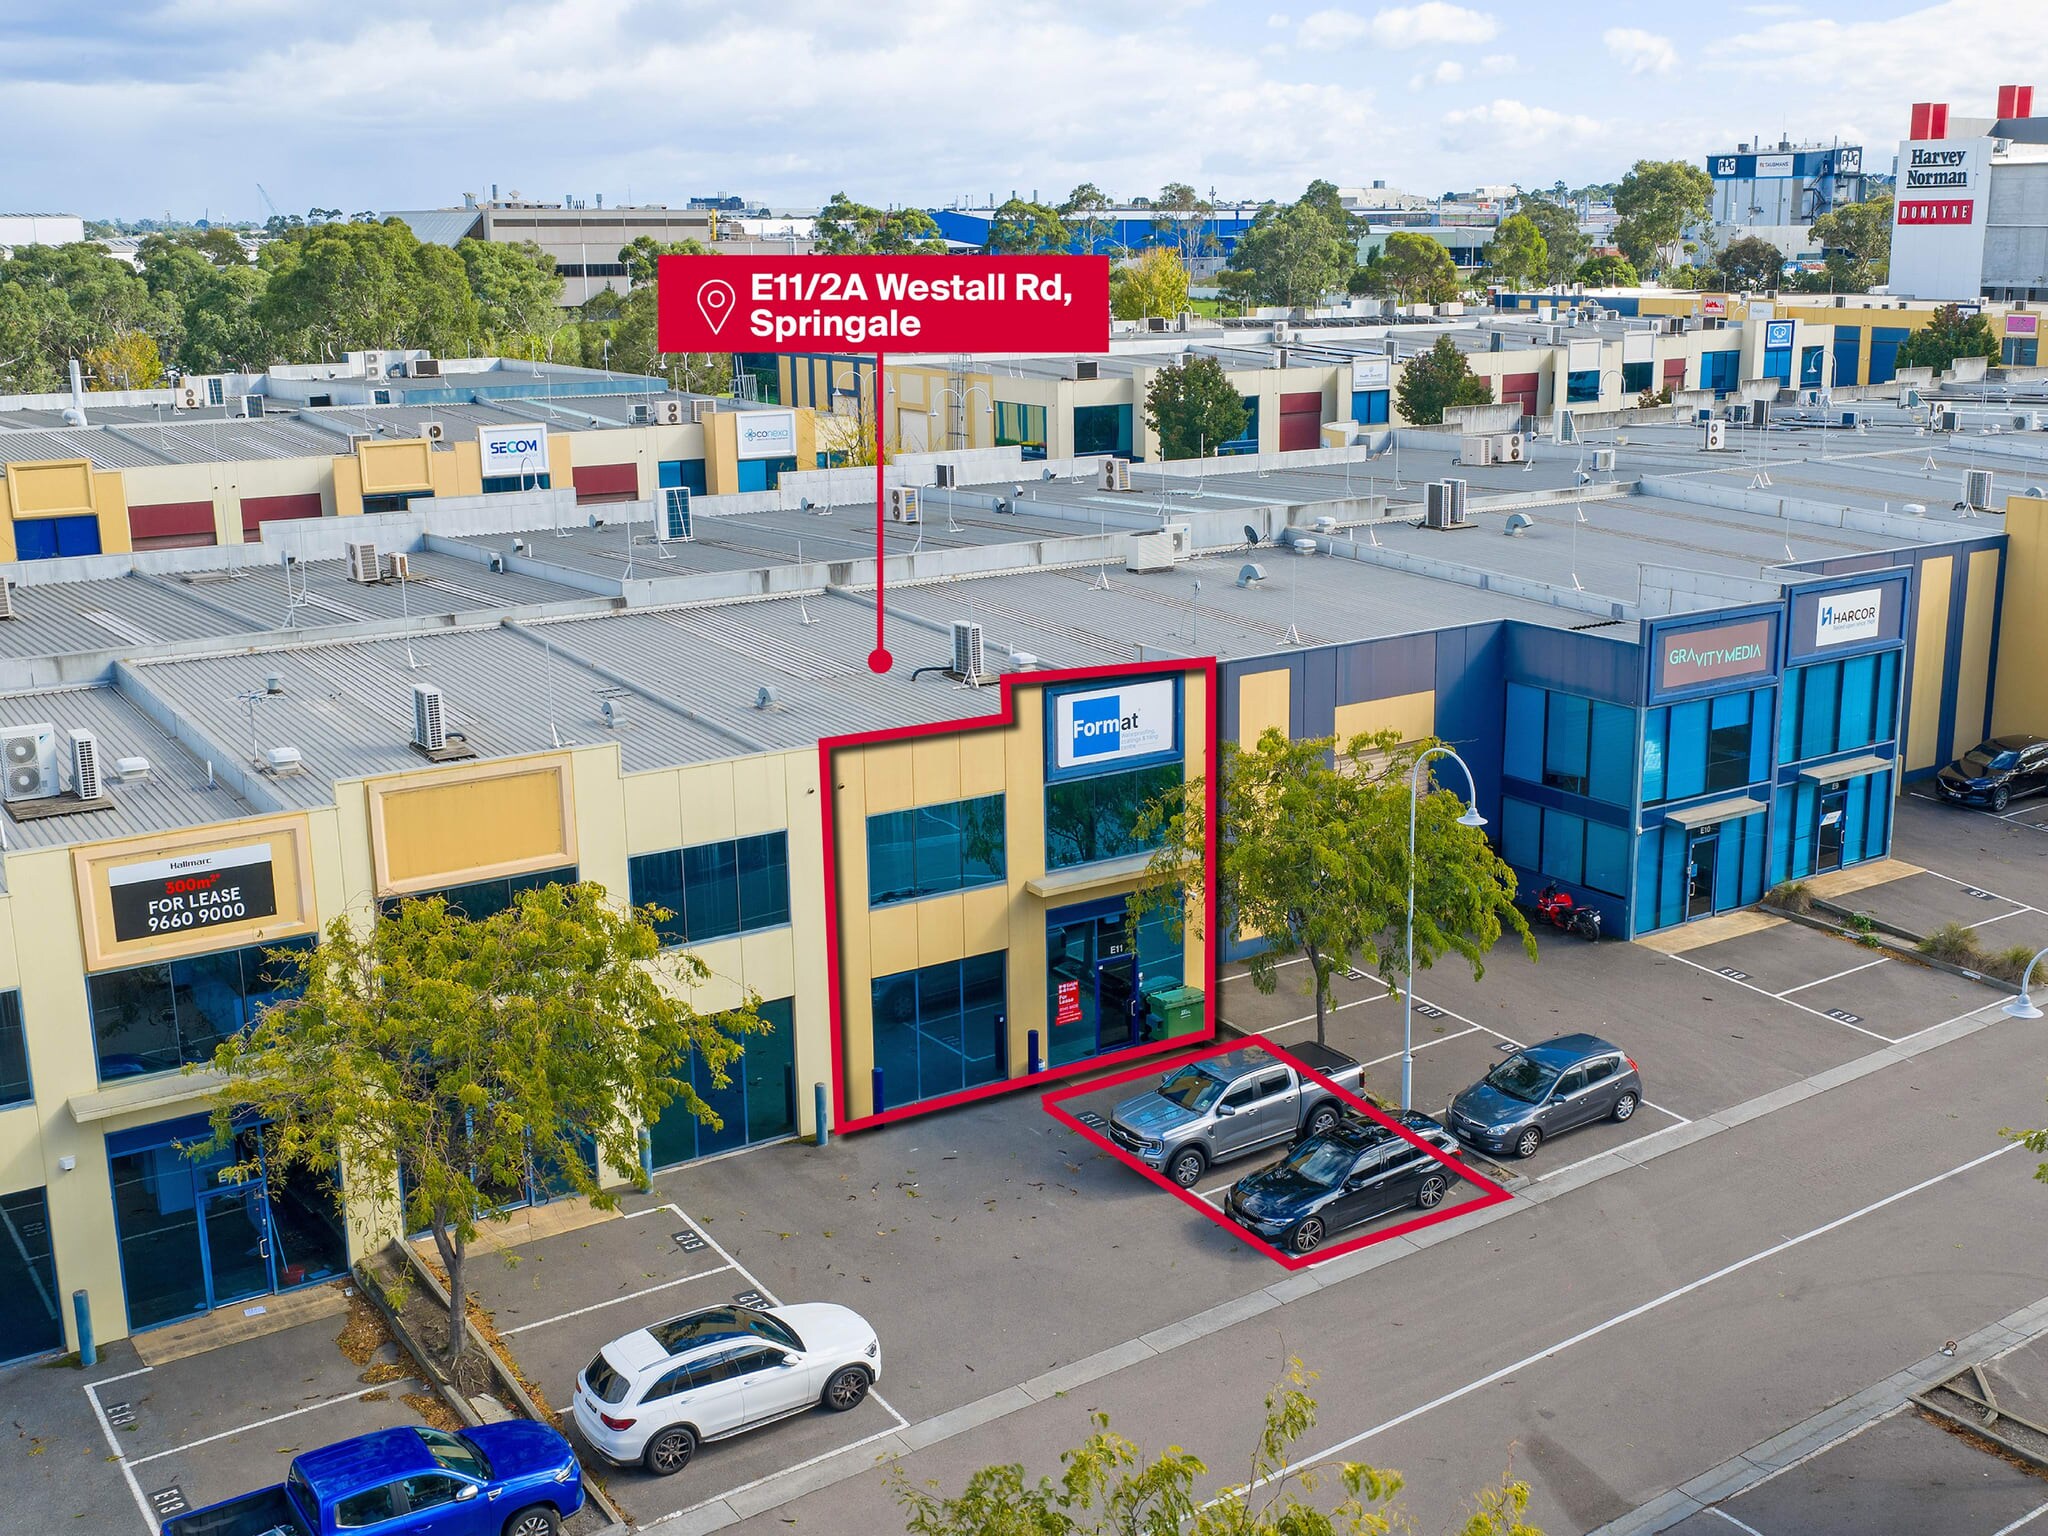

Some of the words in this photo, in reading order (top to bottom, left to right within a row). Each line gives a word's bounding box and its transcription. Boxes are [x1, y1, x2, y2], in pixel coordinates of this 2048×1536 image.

[1718, 159, 1735, 172] PPG
[1842, 150, 1859, 167] PPG
[1911, 149, 1967, 167] Harvey
[1907, 170, 1967, 185] Norman
[1901, 205, 1968, 219] DOMAYNE
[490, 440, 537, 454] SECOM
[1833, 607, 1876, 624] HARCOR
[1669, 647, 1725, 668] GRAVITY
[1725, 643, 1761, 663] MEDIA
[1073, 712, 1139, 739] Format
[1700, 825, 1711, 834] E10
[169, 857, 212, 871] Hallmarc
[148, 897, 184, 915] FOR
[189, 887, 241, 908] LEASE
[148, 911, 193, 932] 9660
[198, 902, 245, 924] 9000
[1110, 944, 1123, 954] E11
[1721, 968, 1747, 980] E10
[1417, 1006, 1443, 1018] E10
[1830, 1010, 1858, 1023] E10
[676, 1232, 705, 1250] E12
[107, 1403, 137, 1426] E13
[153, 1488, 185, 1514] E13
